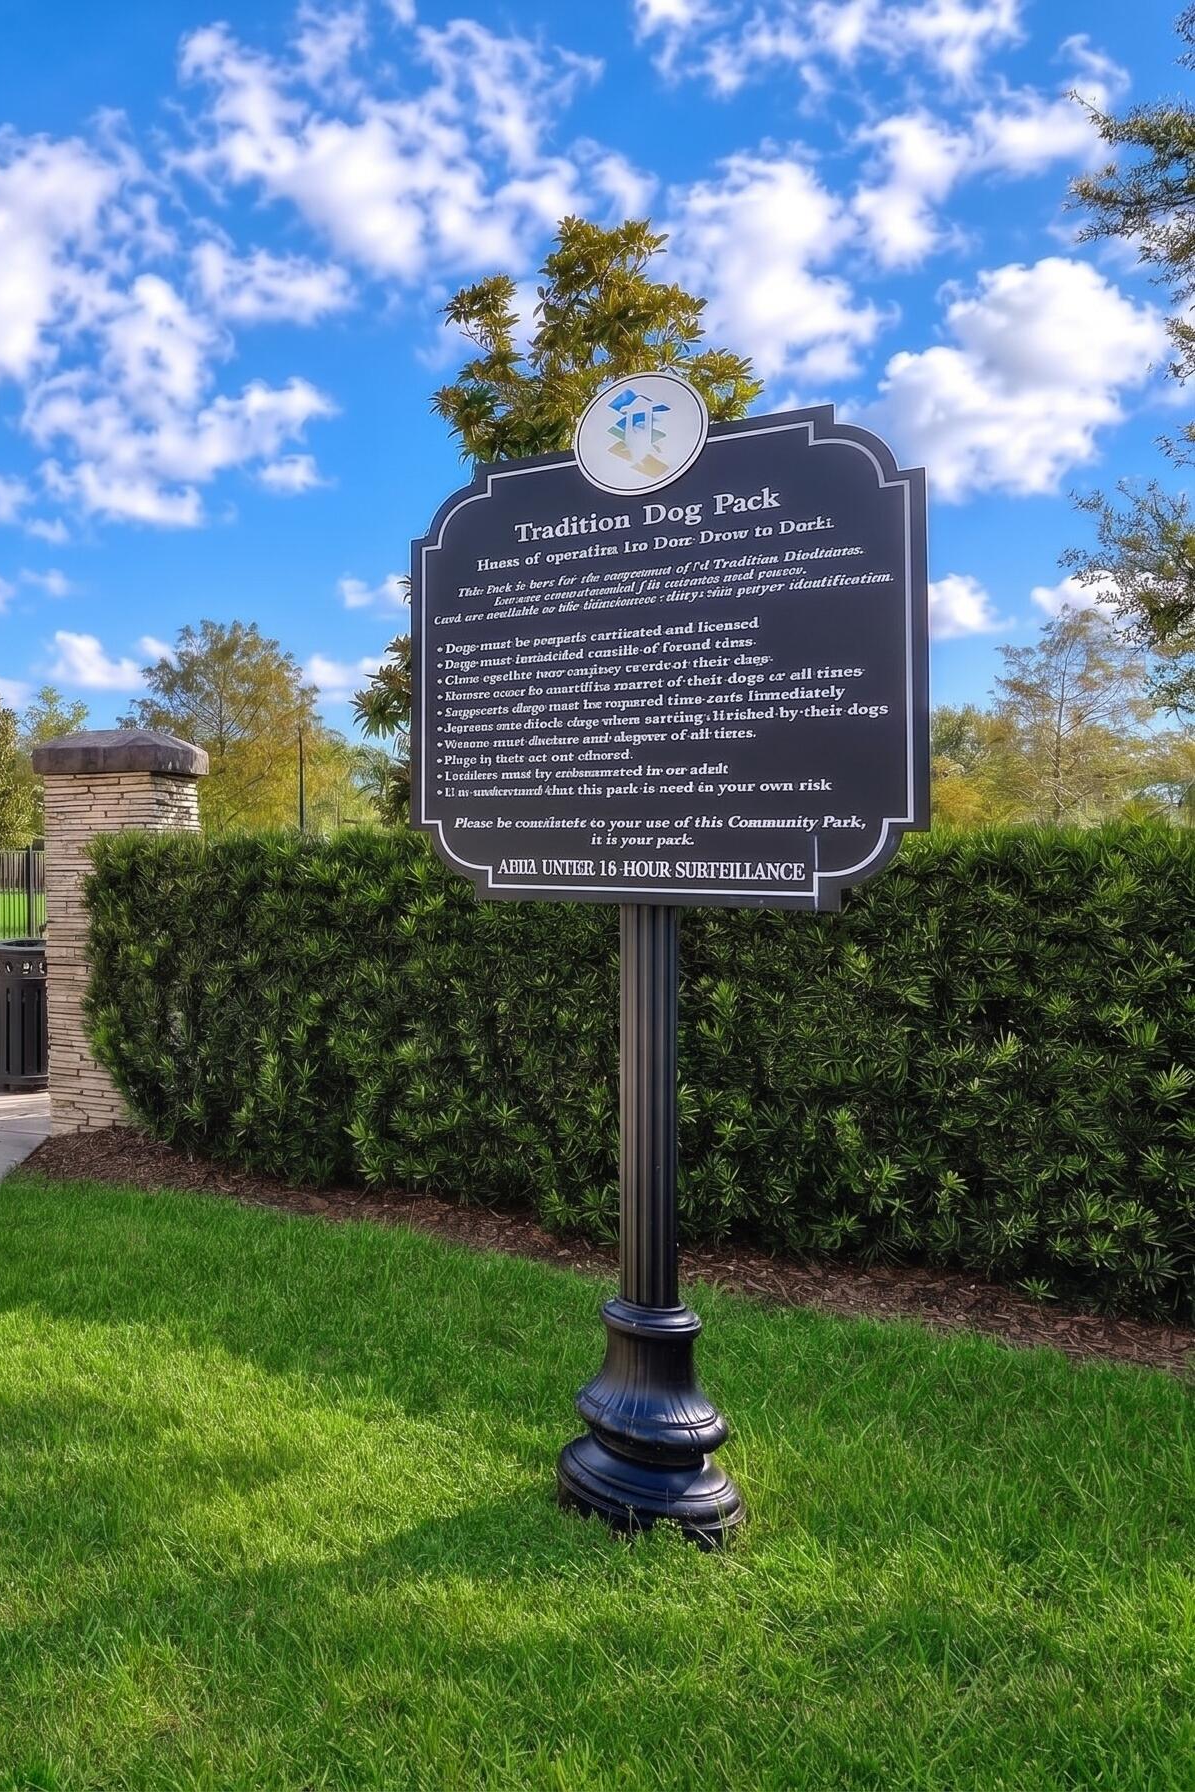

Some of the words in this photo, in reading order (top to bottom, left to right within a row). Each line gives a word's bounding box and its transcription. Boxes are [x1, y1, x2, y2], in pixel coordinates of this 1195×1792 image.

[514, 513, 631, 543] Tradition
[643, 503, 703, 526] Dog
[713, 487, 781, 515] Pack
[525, 552, 542, 565] of
[676, 561, 692, 575] of
[515, 637, 531, 648] be
[665, 622, 694, 636] and
[697, 616, 760, 633] licensed
[480, 655, 512, 667] must
[692, 655, 731, 668] their
[667, 675, 684, 688] of
[687, 673, 723, 686] their
[727, 672, 765, 687] dogs
[747, 685, 846, 702] Immediately
[779, 706, 799, 722] by
[804, 704, 843, 717] their
[847, 702, 889, 719] dogs
[670, 728, 688, 741] of
[577, 783, 603, 795] this
[605, 782, 639, 798] park
[643, 782, 656, 794] is
[659, 781, 695, 794] need
[717, 782, 756, 797] your
[759, 781, 794, 792] own
[797, 778, 833, 792] risk
[454, 817, 494, 829] Please
[496, 817, 513, 829] be
[607, 818, 643, 832] your
[645, 818, 670, 829] use
[674, 816, 693, 829] of
[694, 816, 723, 829] this
[727, 815, 819, 832] Community
[821, 815, 867, 830] Park,
[590, 833, 602, 845] it
[606, 833, 618, 845] is
[619, 835, 654, 849] your
[655, 832, 695, 849] park.
